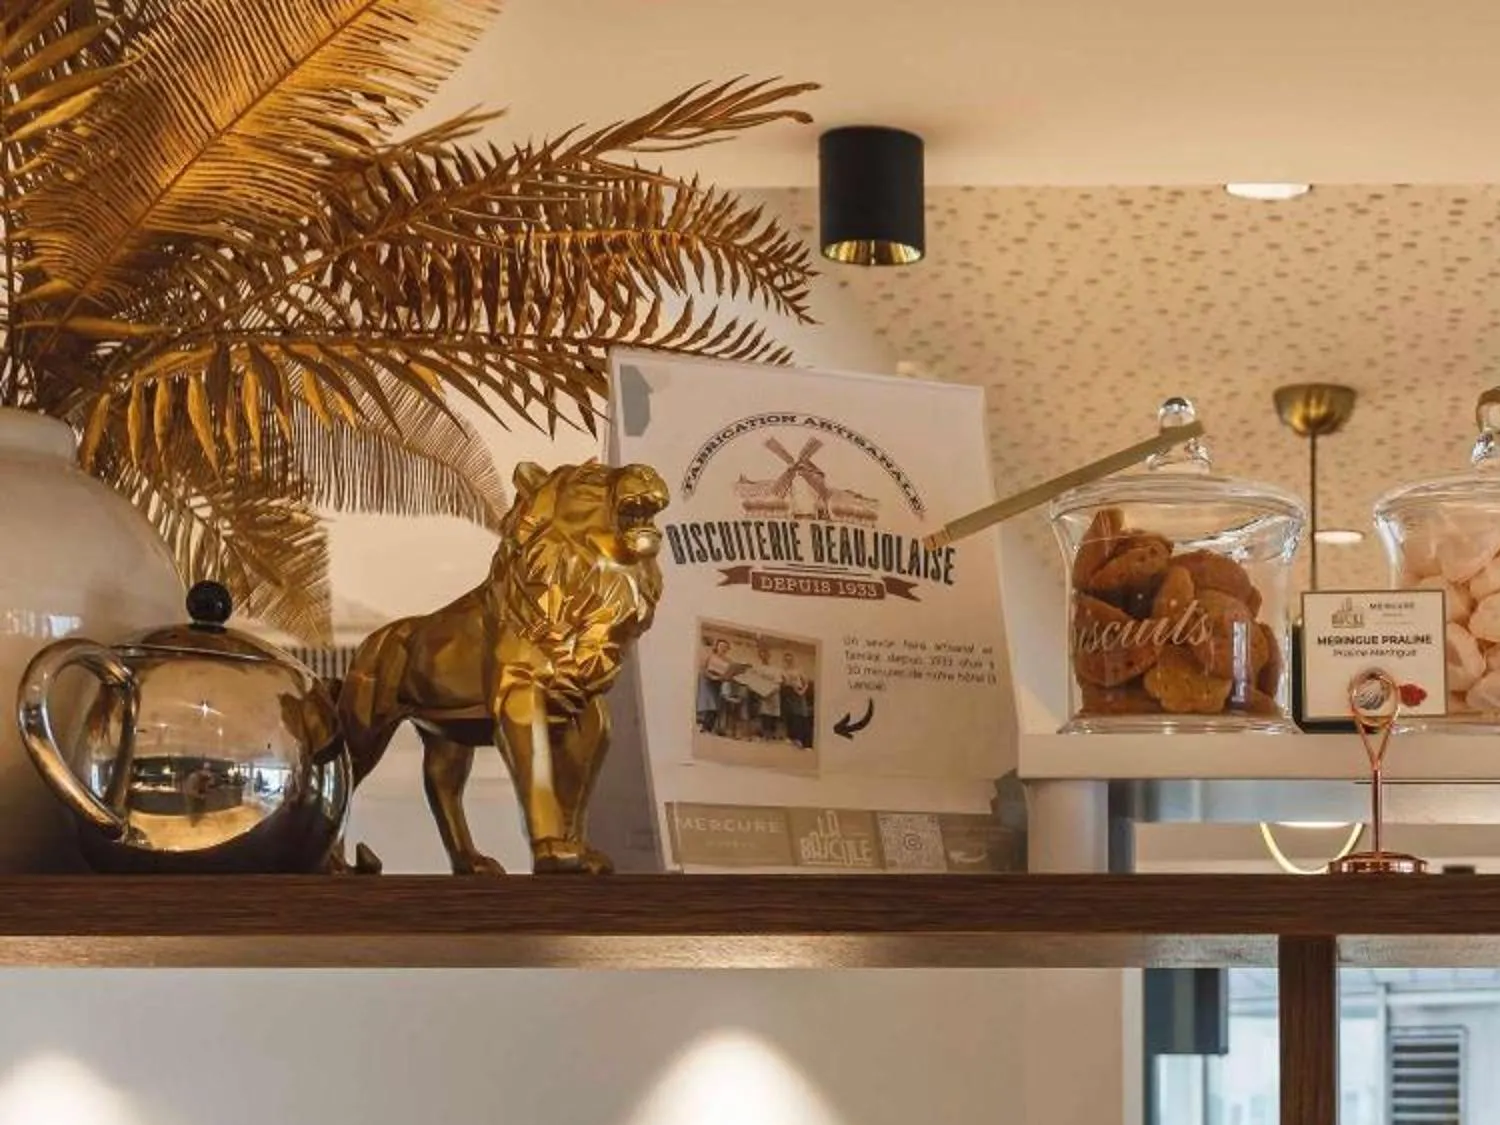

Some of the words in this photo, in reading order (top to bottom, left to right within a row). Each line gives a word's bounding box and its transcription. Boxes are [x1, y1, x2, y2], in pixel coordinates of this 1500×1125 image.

[686, 414, 797, 489] FABRICATION
[665, 520, 804, 565] BISCUITERIE
[810, 523, 956, 585] BEAUJOLAISE
[761, 577, 831, 594] DEPUIS
[1317, 635, 1379, 646] MERINGUE
[1381, 634, 1433, 645] PRALINE
